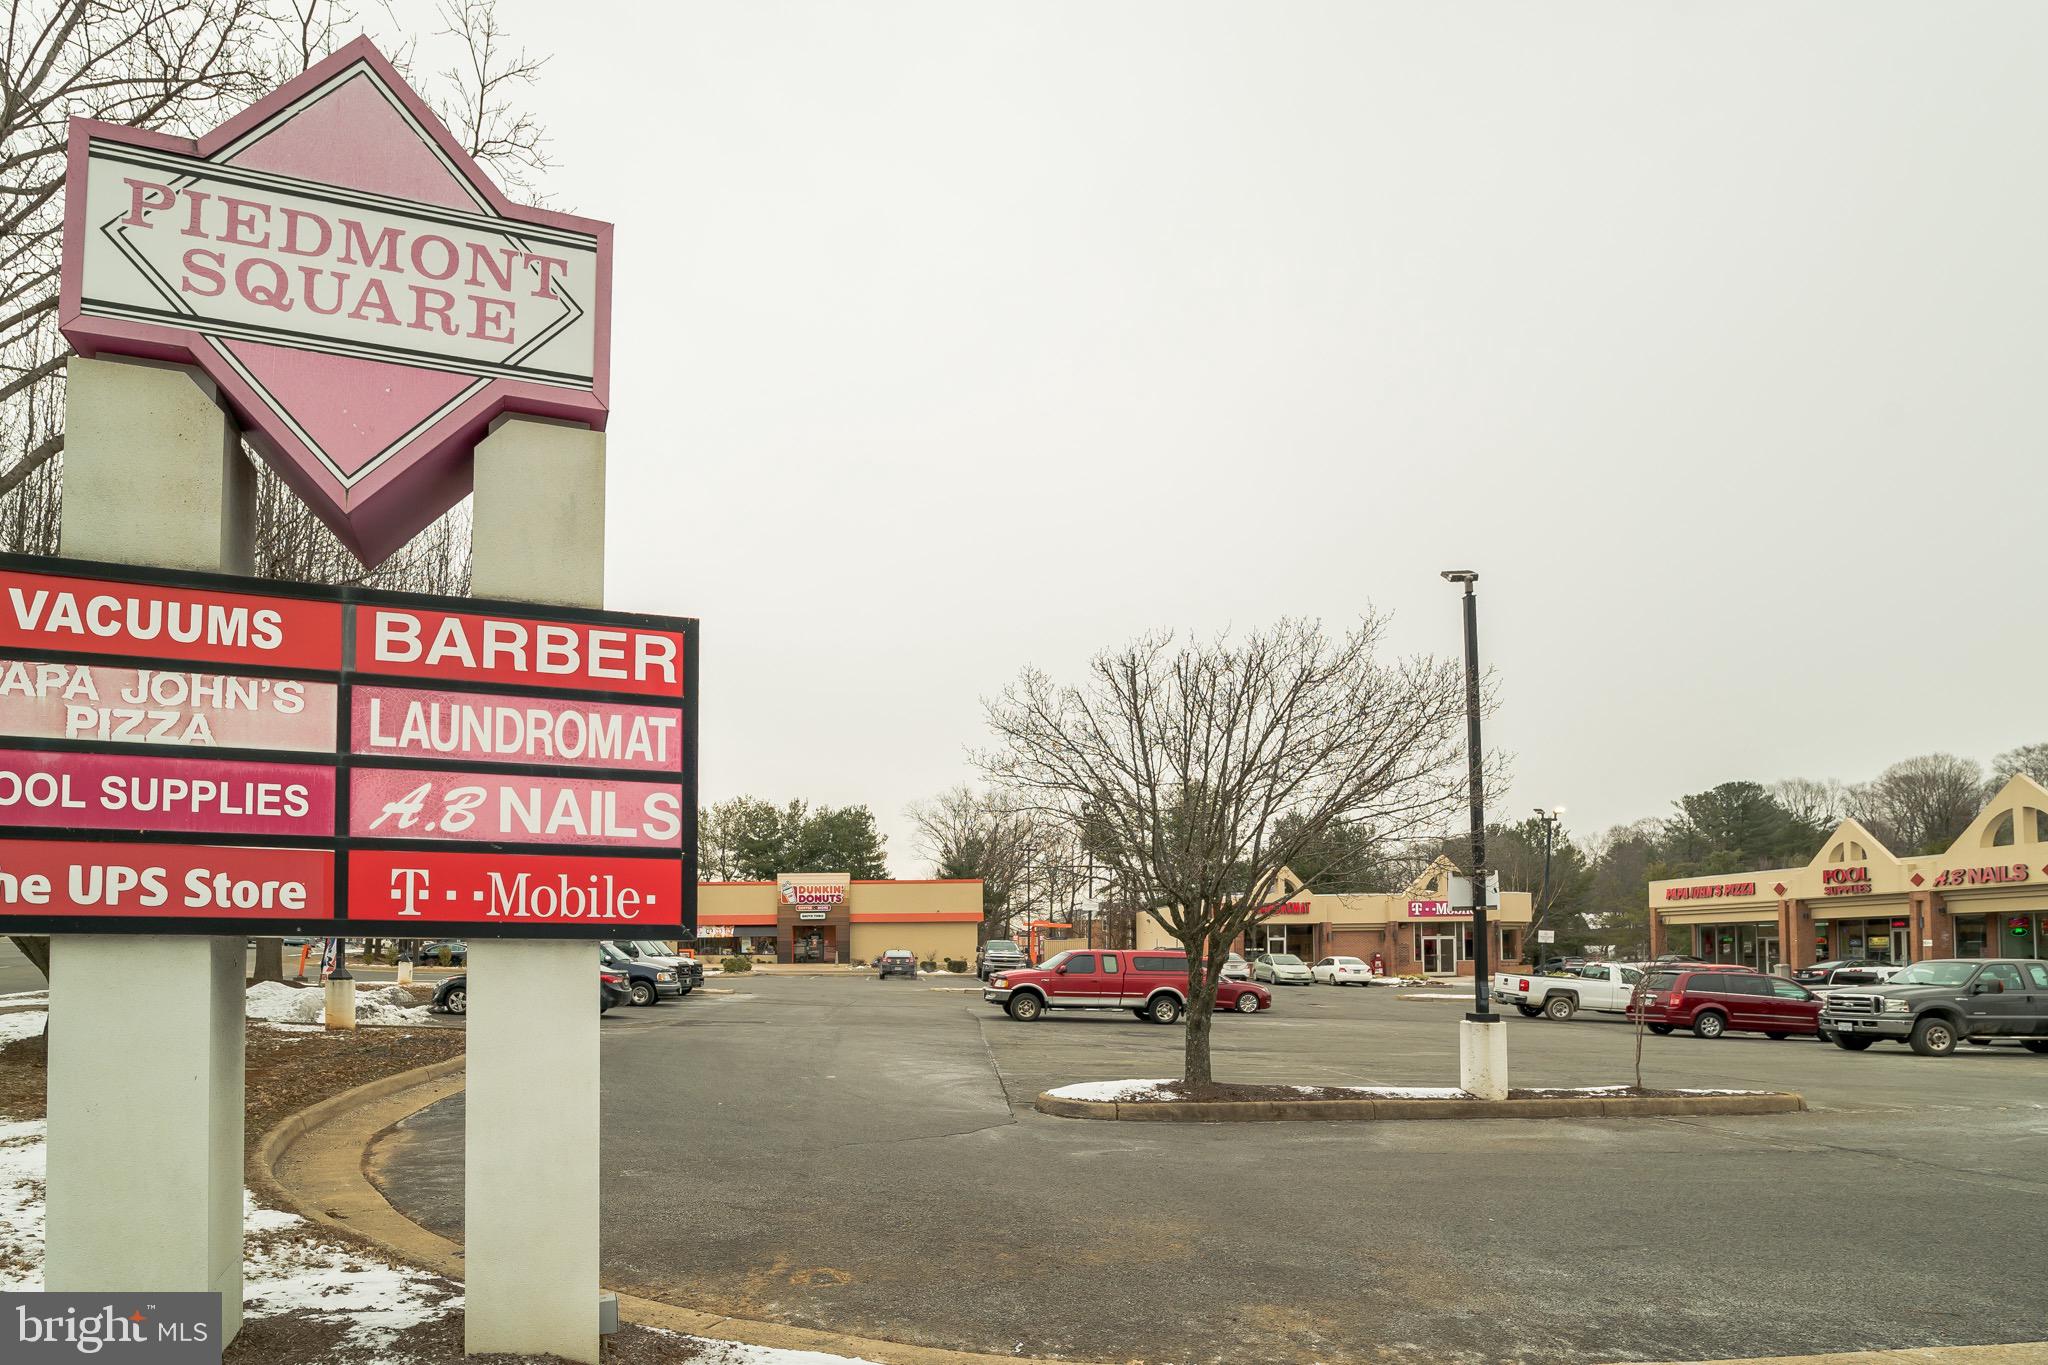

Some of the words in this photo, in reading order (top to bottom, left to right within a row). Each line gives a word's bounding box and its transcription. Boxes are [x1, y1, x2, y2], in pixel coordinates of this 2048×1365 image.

[121, 177, 569, 301] PIEDMONT
[181, 248, 516, 345] SQUARE
[8, 587, 283, 650] VACUUMS
[374, 611, 678, 683] BARBER
[121, 669, 305, 714] JOHN'S
[64, 704, 219, 747] PIZZA
[369, 698, 677, 762] LAUNDROMAT
[100, 775, 309, 817] SUPPLIES
[499, 786, 681, 840] NAILS
[68, 864, 169, 907] UPS
[184, 868, 307, 910] Store
[1724, 882, 1756, 897] PIZZA
[1823, 866, 1872, 884] POOL
[1823, 883, 1872, 896] SUPPLIES
[1967, 863, 2029, 884] NAILS
[798, 894, 842, 903] DONUTS
